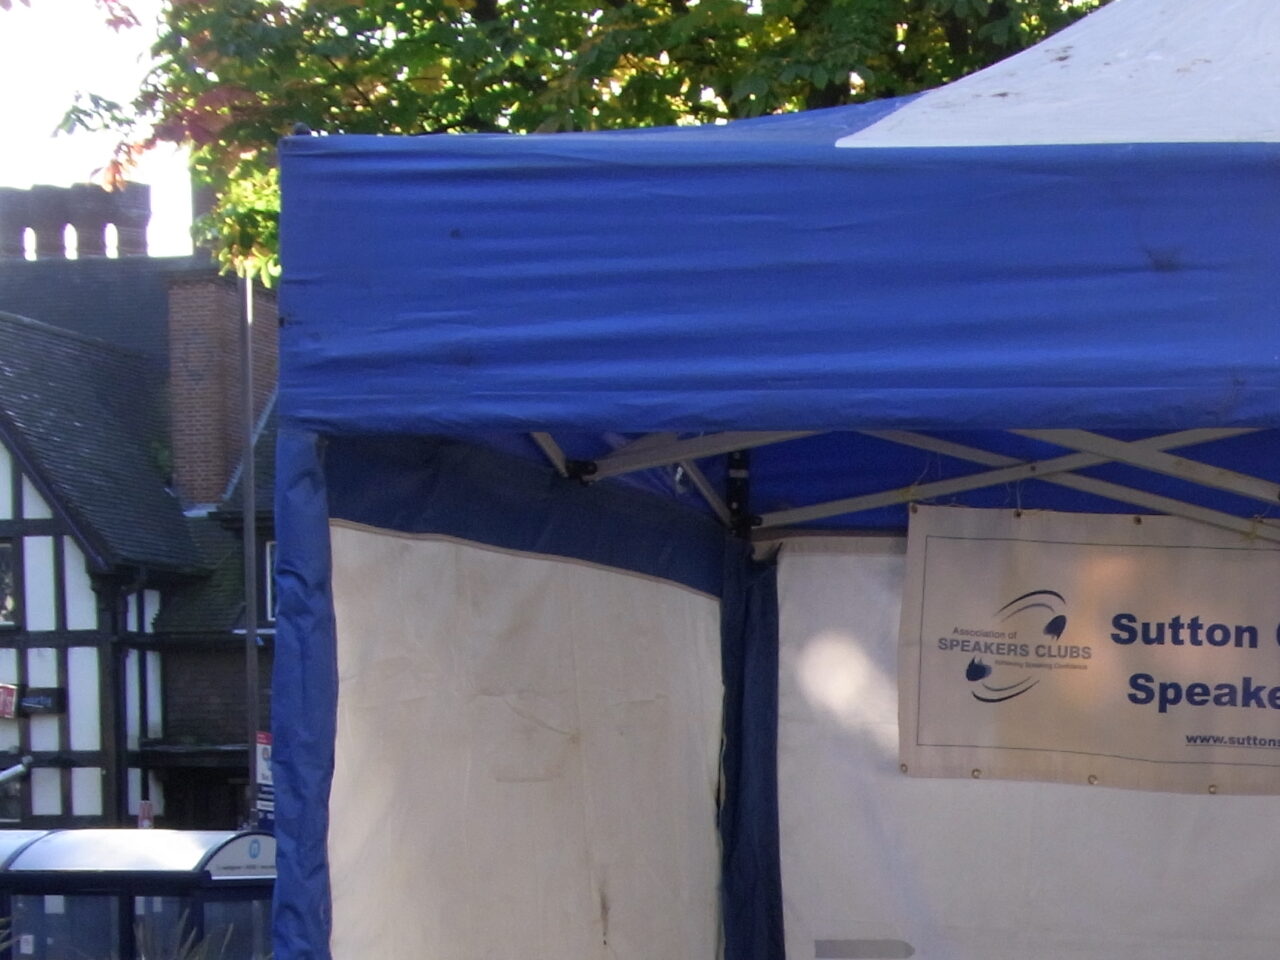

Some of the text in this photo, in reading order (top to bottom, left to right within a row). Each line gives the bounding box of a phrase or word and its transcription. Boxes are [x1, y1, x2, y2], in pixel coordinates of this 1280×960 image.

[952, 626, 1018, 640] Association of
[1110, 612, 1258, 649] Sutton
[938, 637, 1092, 660] SPEAKERS CLUBS
